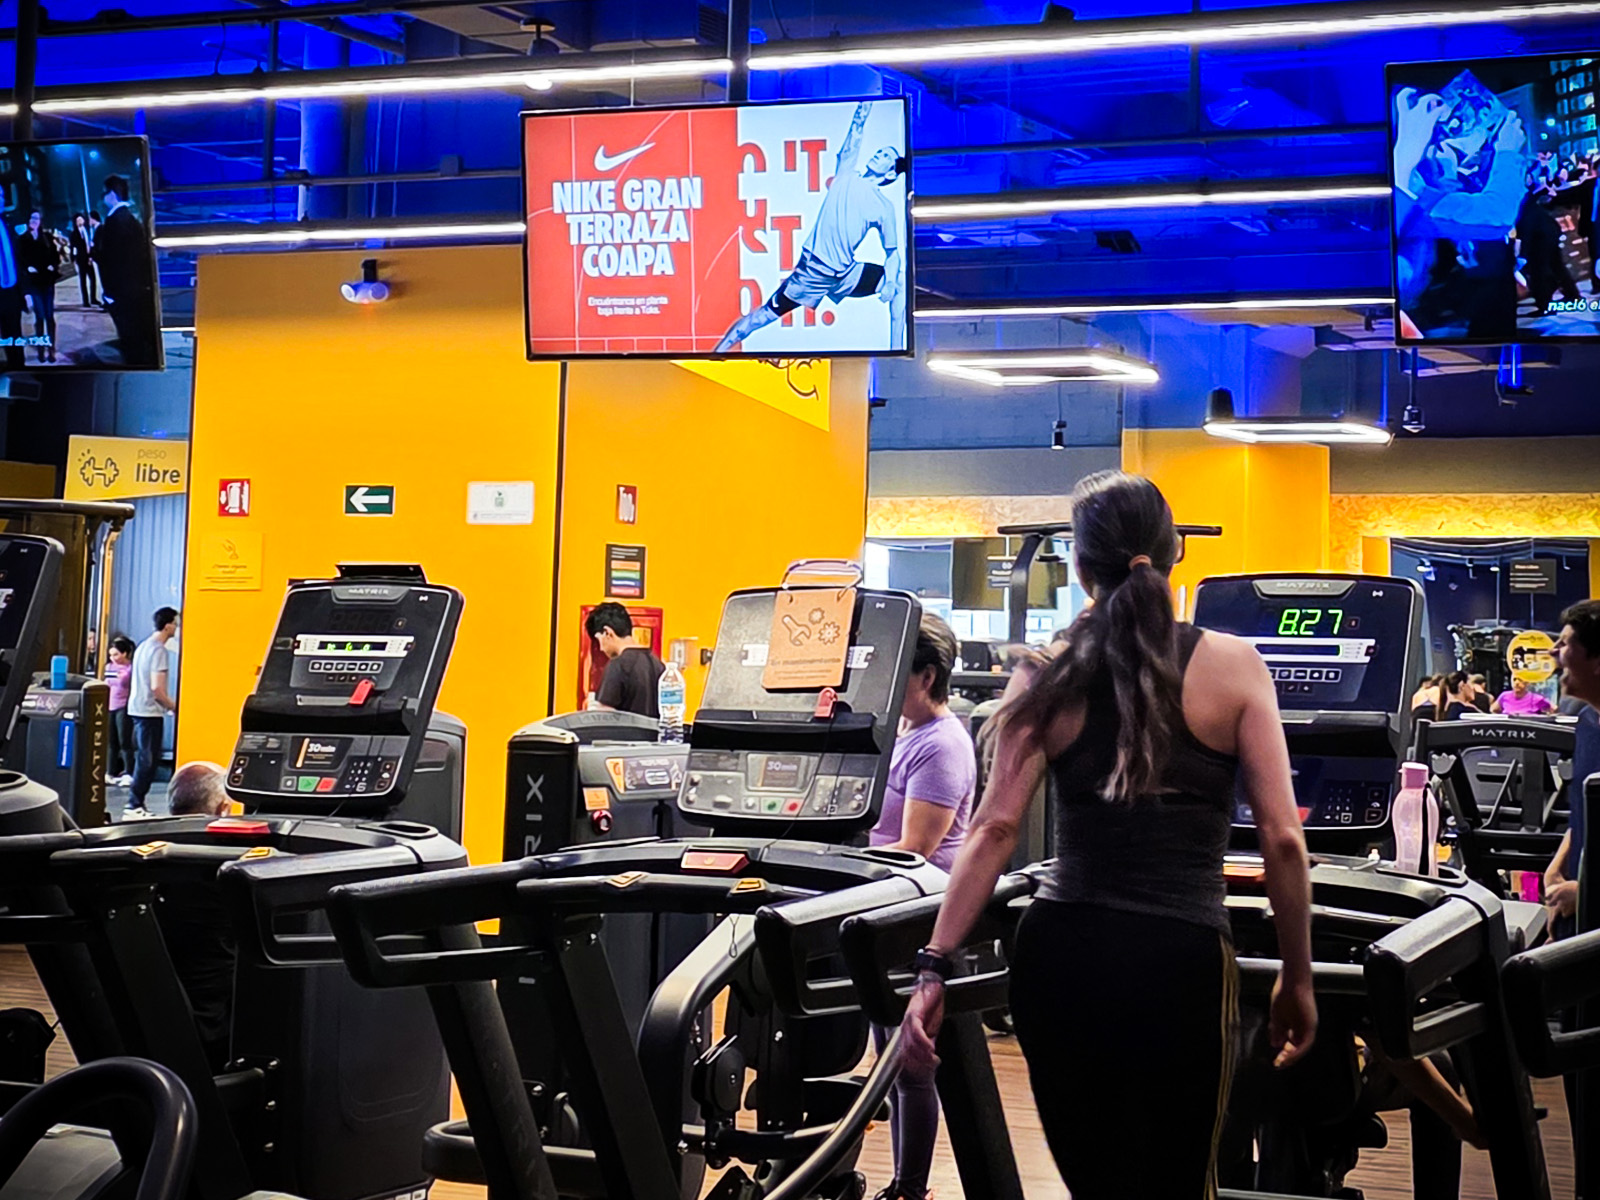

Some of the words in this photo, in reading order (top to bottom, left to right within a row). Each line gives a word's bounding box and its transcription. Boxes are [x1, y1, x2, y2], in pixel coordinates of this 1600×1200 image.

[552, 180, 616, 214] NIKE
[622, 176, 702, 211] GRAN
[565, 210, 690, 246] TERRAZA
[582, 243, 675, 277] COAPA
[136, 448, 167, 461] peso
[135, 462, 181, 484] libre
[1471, 727, 1537, 739] MATRIX
[90, 702, 104, 803] MATRIX
